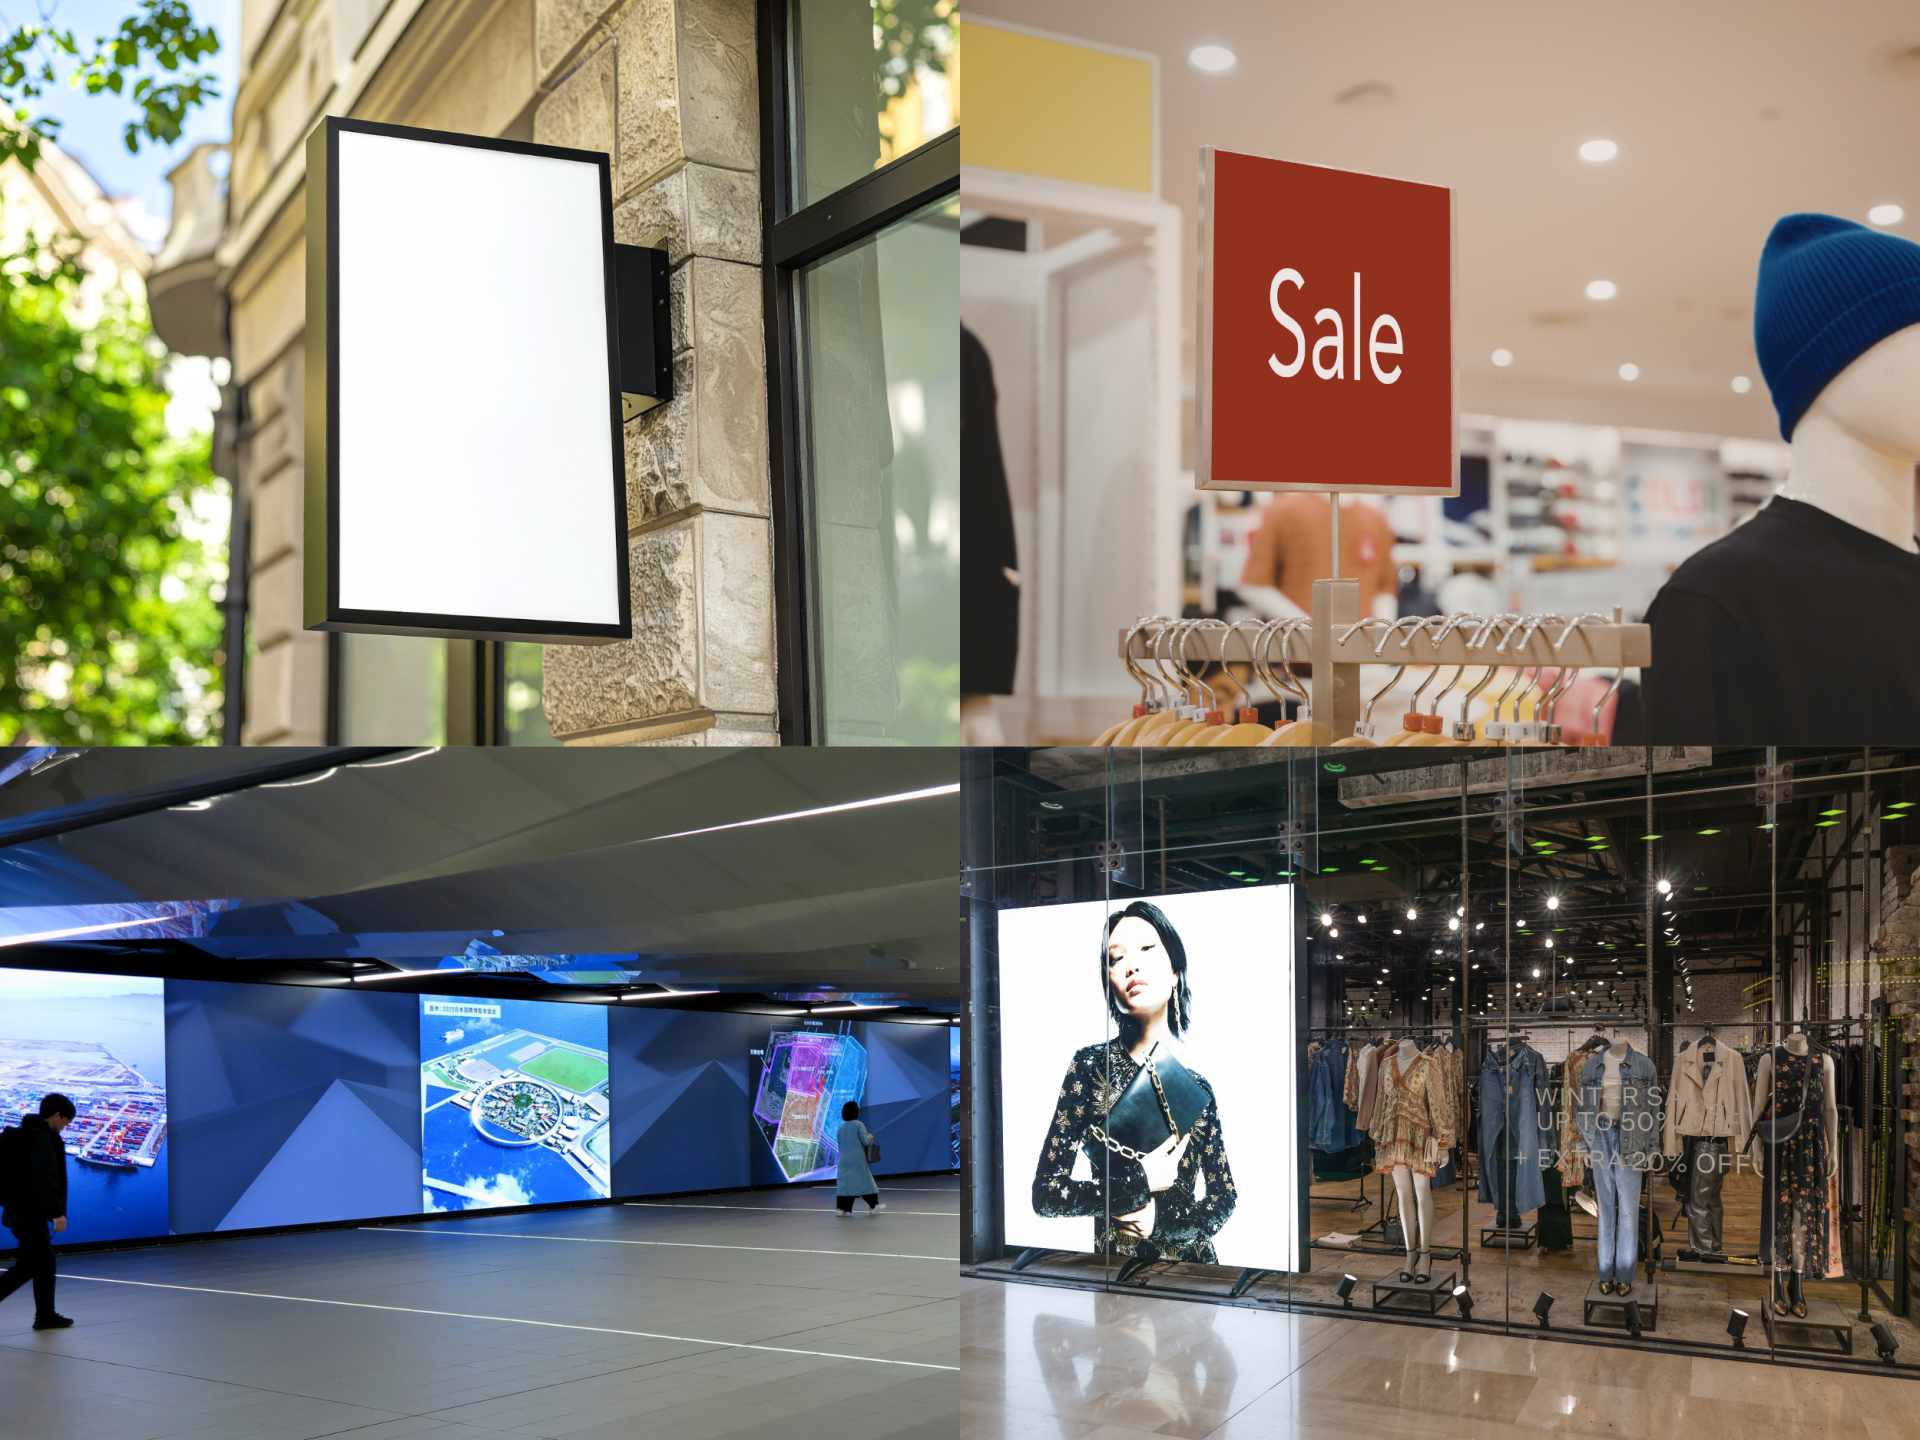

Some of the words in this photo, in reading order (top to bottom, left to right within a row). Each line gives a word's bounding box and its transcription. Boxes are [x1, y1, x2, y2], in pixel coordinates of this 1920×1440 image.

[1268, 267, 1404, 385] Sale
[1355, 726, 1364, 735] XL
[1535, 1086, 1639, 1106] WINTER
[1647, 1086, 1718, 1106] SALE
[1537, 1111, 1571, 1131] UP
[1577, 1111, 1613, 1131] TO
[1621, 1111, 1676, 1132] 50%
[1685, 1112, 1739, 1133] OFF
[1538, 1148, 1625, 1170] EXTRA
[1632, 1151, 1687, 1173] 20%
[1696, 1153, 1751, 1175] OFF
